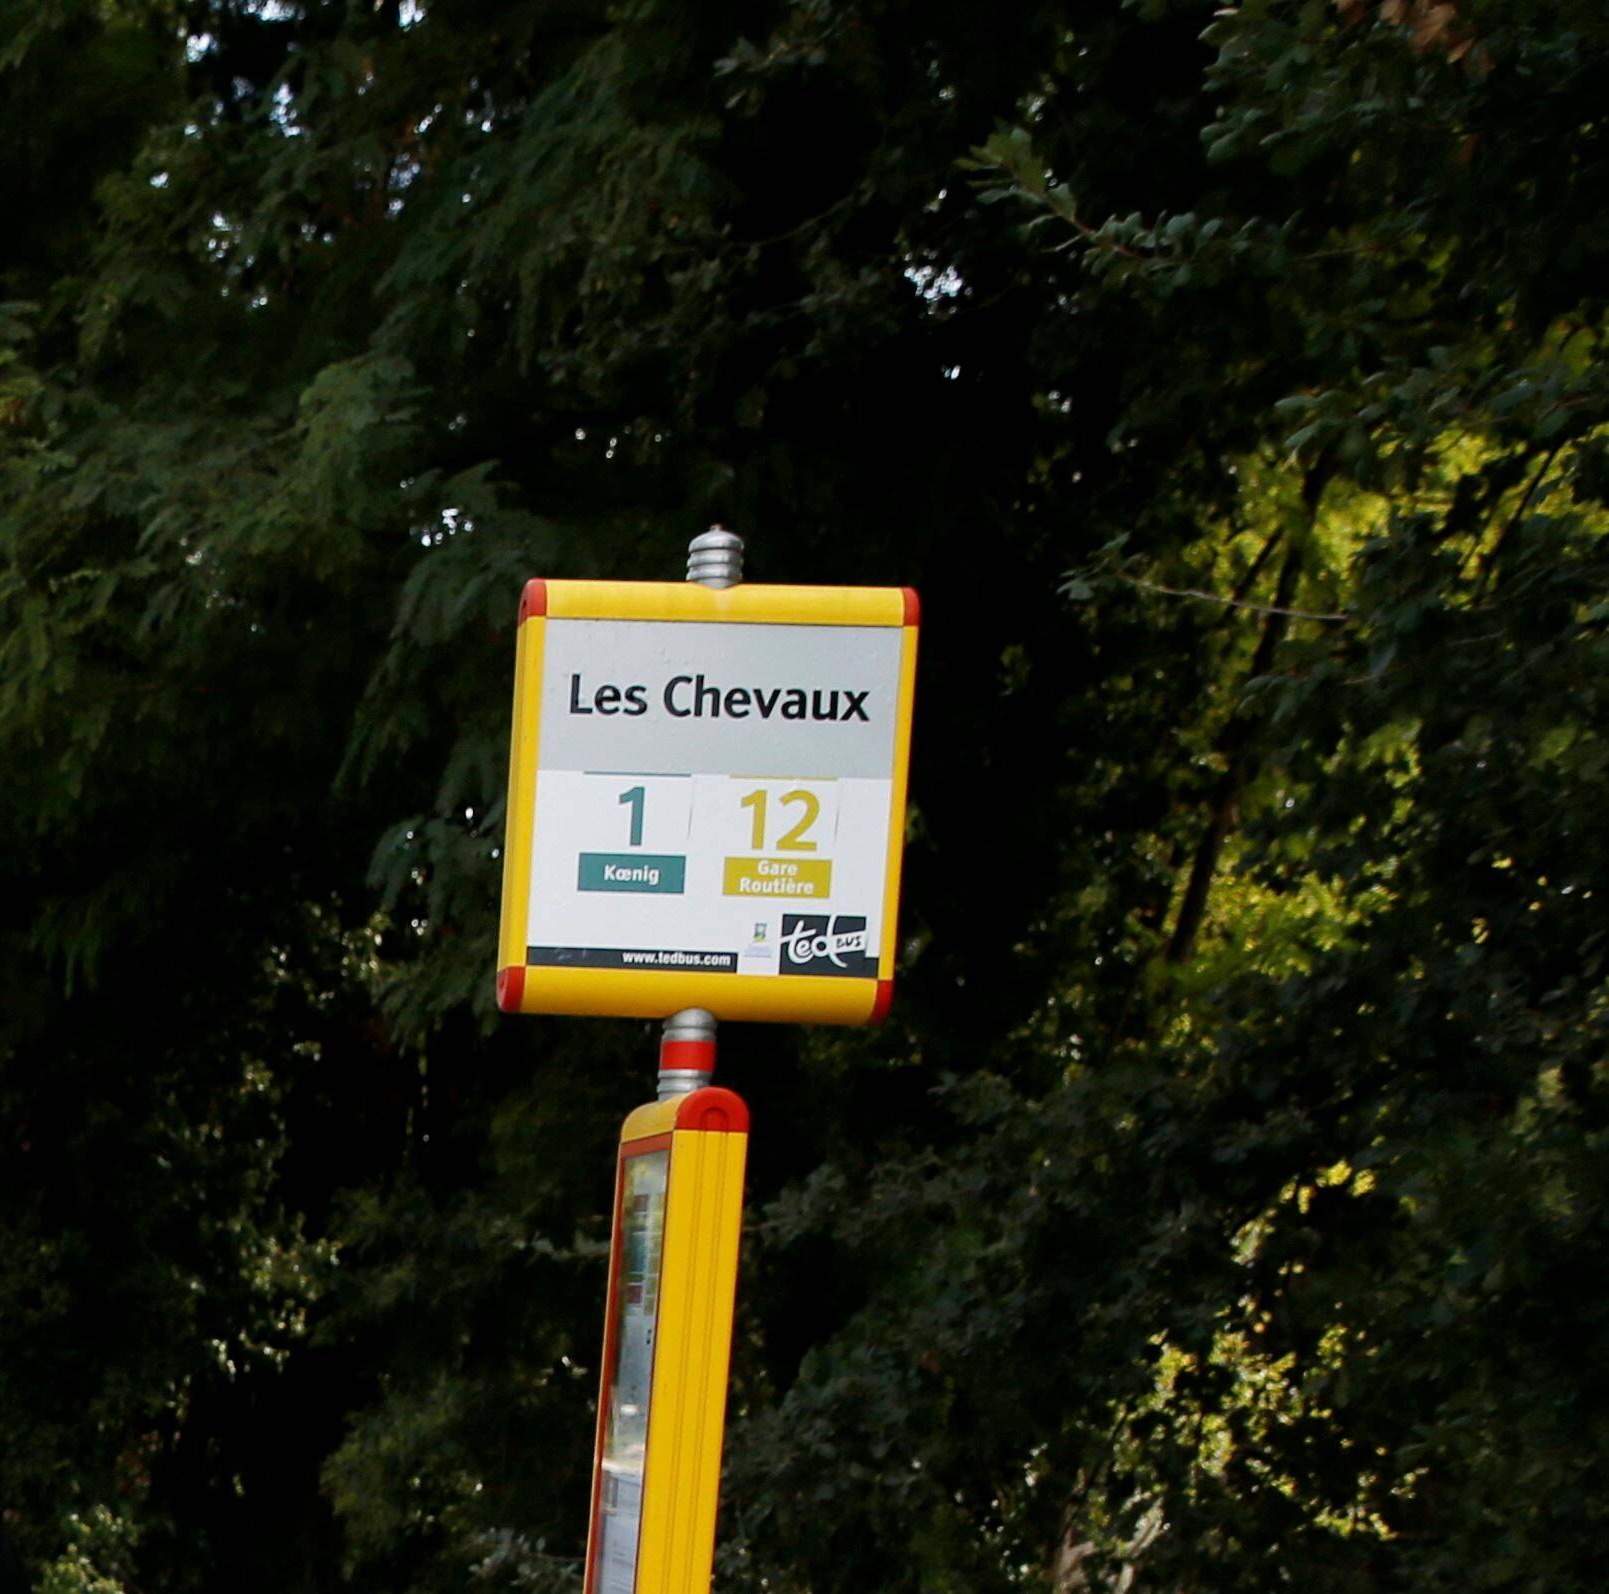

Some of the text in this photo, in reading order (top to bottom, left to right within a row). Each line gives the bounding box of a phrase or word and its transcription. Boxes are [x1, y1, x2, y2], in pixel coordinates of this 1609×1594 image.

[569, 673, 871, 722] Les Chevaux
[618, 785, 646, 847] 1
[739, 788, 821, 852] 12
[603, 863, 661, 885] Kœnig
[756, 859, 799, 877] Gare
[739, 876, 815, 895] Routière
[779, 913, 848, 969] ted
[836, 935, 863, 949] BUS
[622, 951, 732, 967] www.tedbus.com
